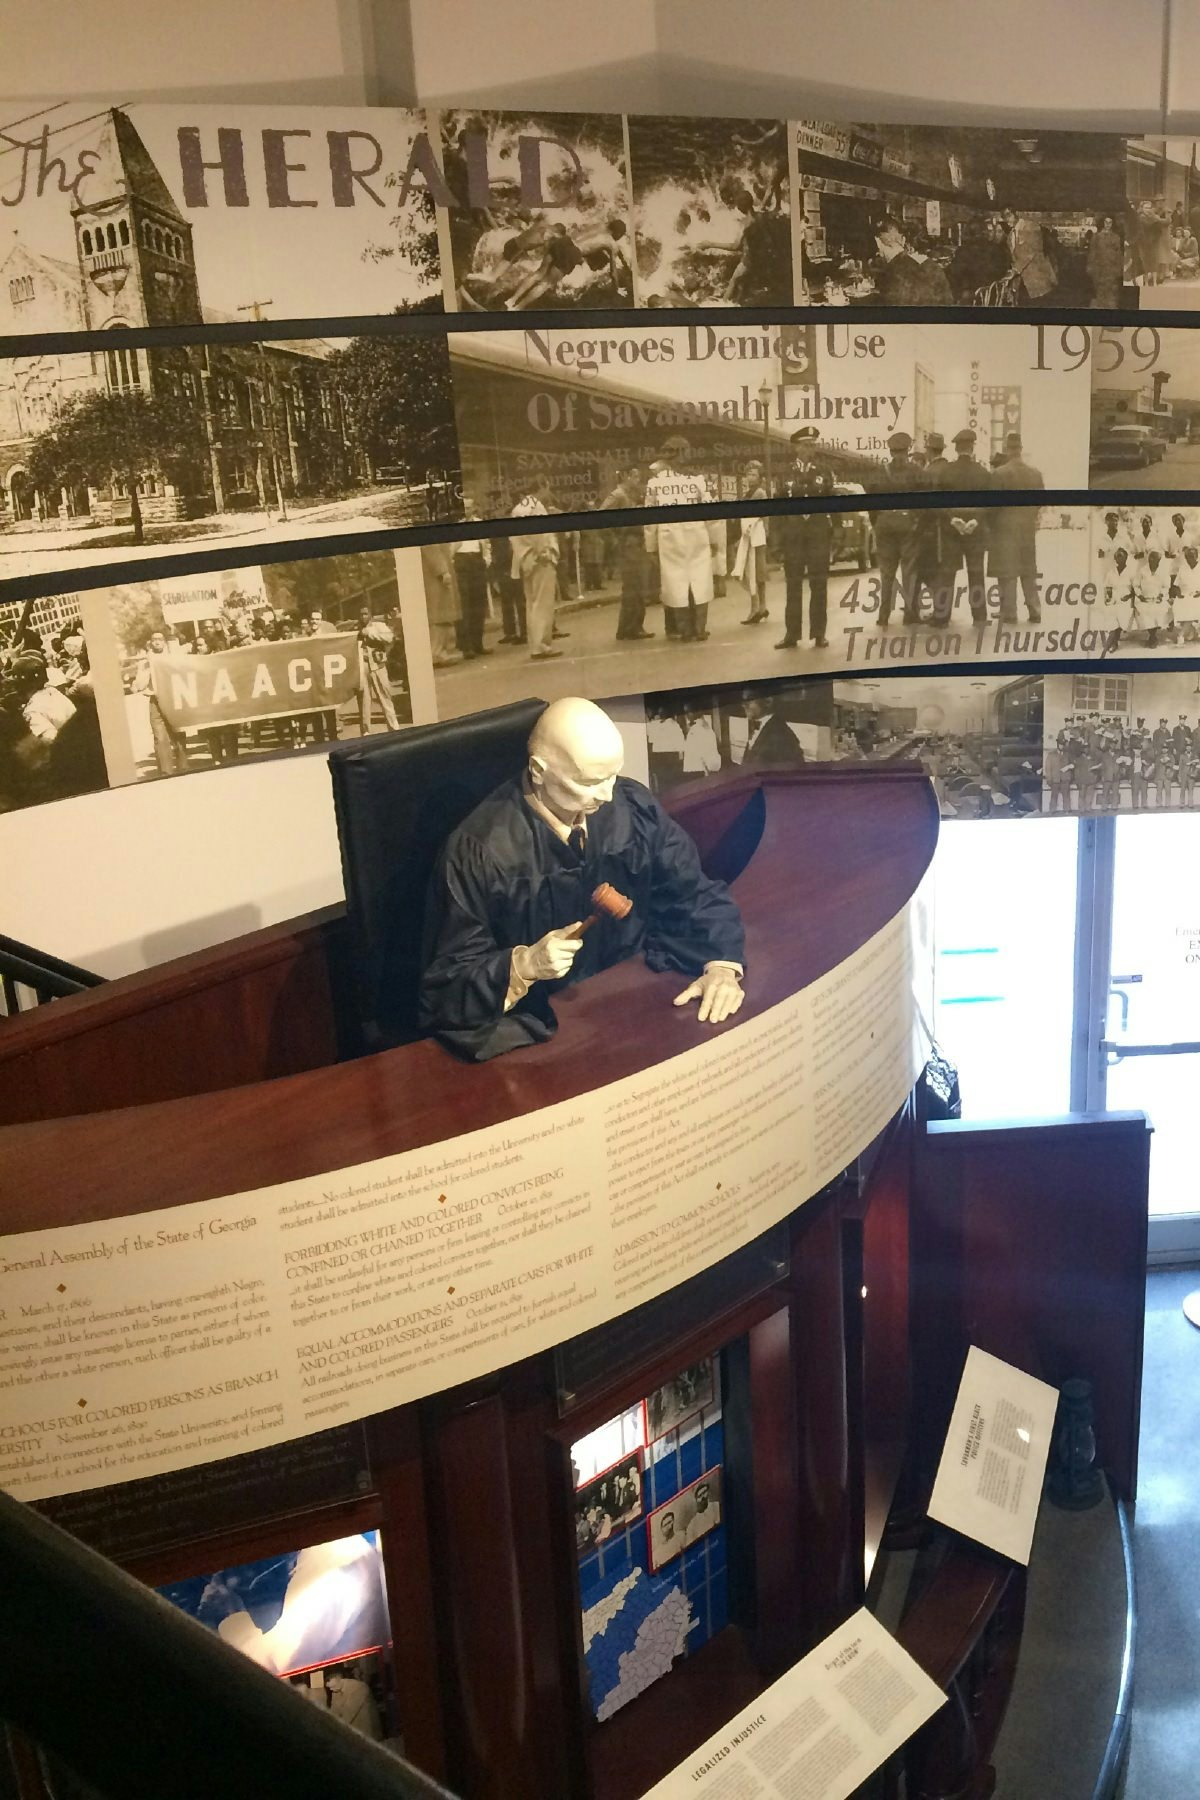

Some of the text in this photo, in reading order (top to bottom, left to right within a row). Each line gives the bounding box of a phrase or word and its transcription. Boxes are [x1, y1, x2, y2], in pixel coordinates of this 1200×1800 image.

[177, 125, 591, 210] HERALD
[524, 323, 887, 378] Negroes Denie Use
[1030, 325, 1161, 374] 1959
[527, 384, 907, 433] Of Savannah Library
[839, 577, 882, 614] 43
[843, 618, 1117, 662] Trial on Thursday
[171, 653, 348, 710] NAACP
[50, 1243, 114, 1266] Assembly
[116, 1238, 130, 1257] of
[134, 1235, 154, 1250] the
[156, 1228, 190, 1246] State
[192, 1224, 204, 1242] of
[208, 1218, 258, 1235] Georgia
[284, 1167, 564, 1264] FORBIDDING WHITE AND COLORED CONVICTS BEING
[286, 1253, 350, 1279] CONFINED
[351, 1248, 369, 1263] OR
[370, 1231, 424, 1257] CHAINED
[428, 1212, 483, 1240] TOGETHER
[296, 1245, 594, 1359] EQUAL ACCOMMODATIONS AND SEPARATE CARS FOR WHITE
[300, 1355, 328, 1373] AND
[328, 1338, 384, 1365] COLORED
[386, 1316, 453, 1348] PASSENGERS
[58, 1414, 84, 1430] FOR
[86, 1401, 148, 1425] COLORED
[148, 1387, 204, 1411] PERSONS
[206, 1382, 224, 1397] AS
[224, 1368, 279, 1392] BRANCH
[690, 1714, 768, 1782] LEGALIZED INJUSTICE
